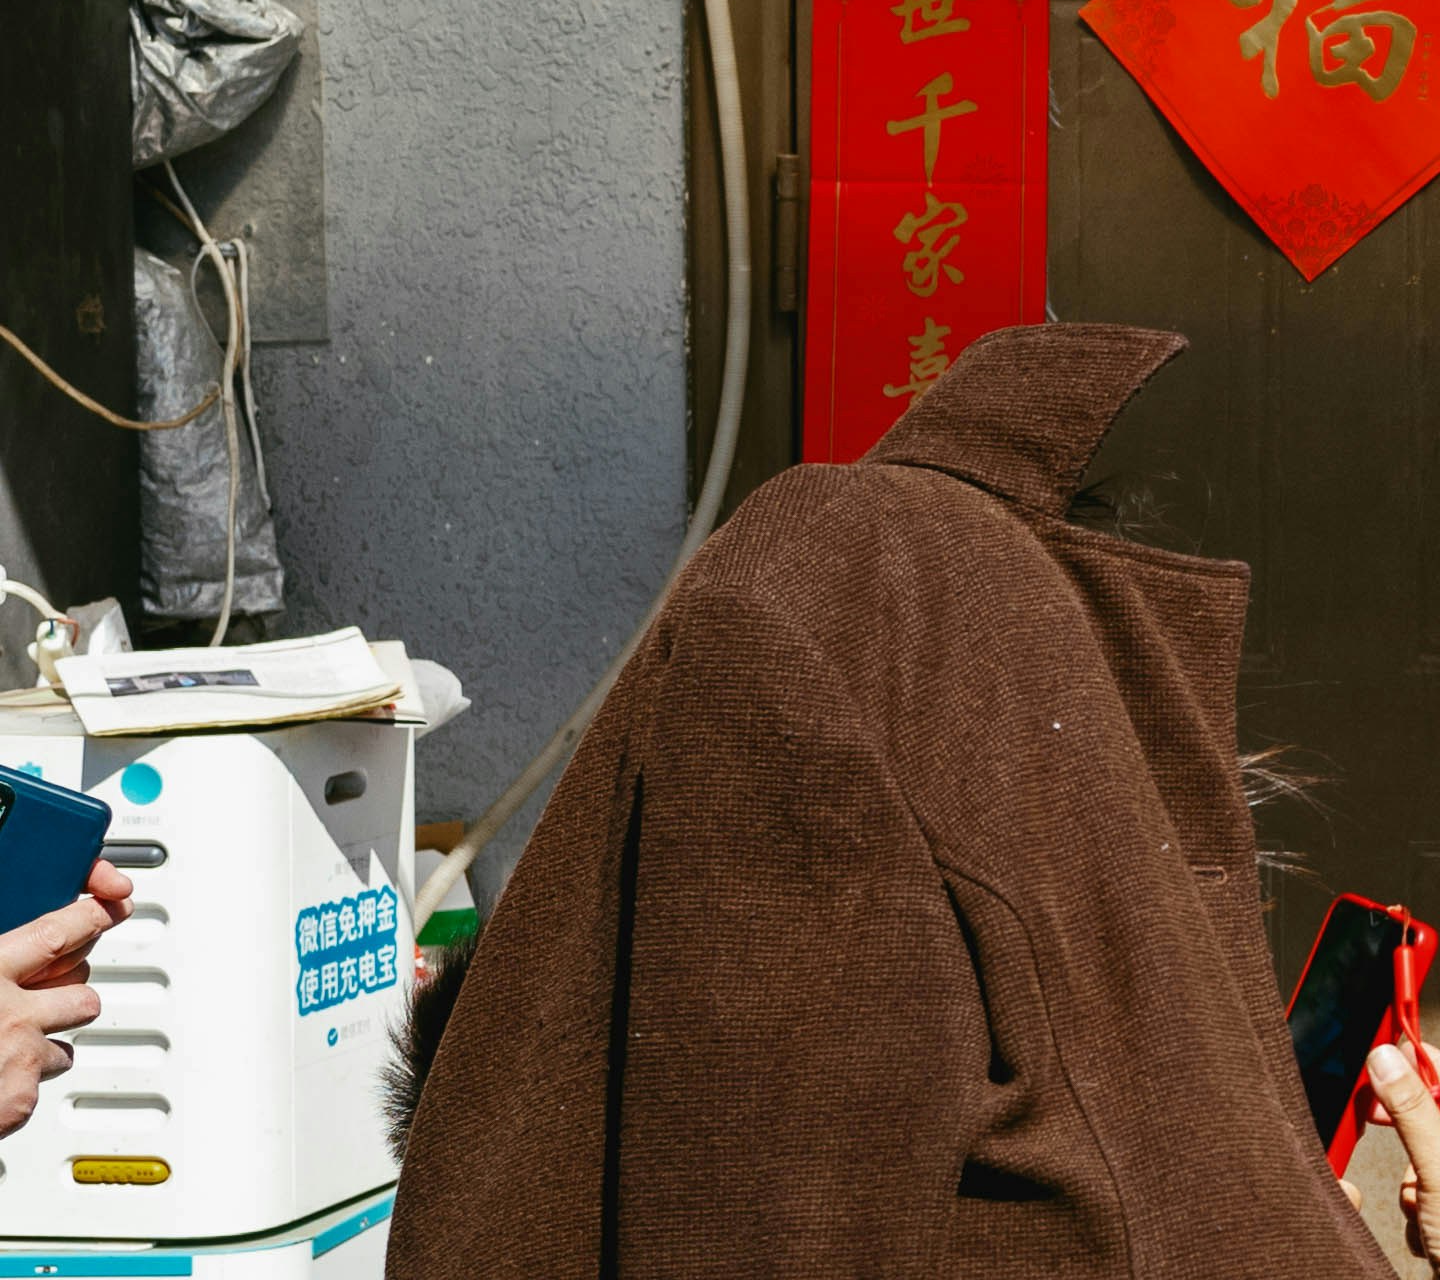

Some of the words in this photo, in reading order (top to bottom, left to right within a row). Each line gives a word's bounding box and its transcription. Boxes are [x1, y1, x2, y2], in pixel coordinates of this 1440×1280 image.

[298, 892, 396, 957] 微信免押金
[299, 944, 396, 1009] 使用充电宝
